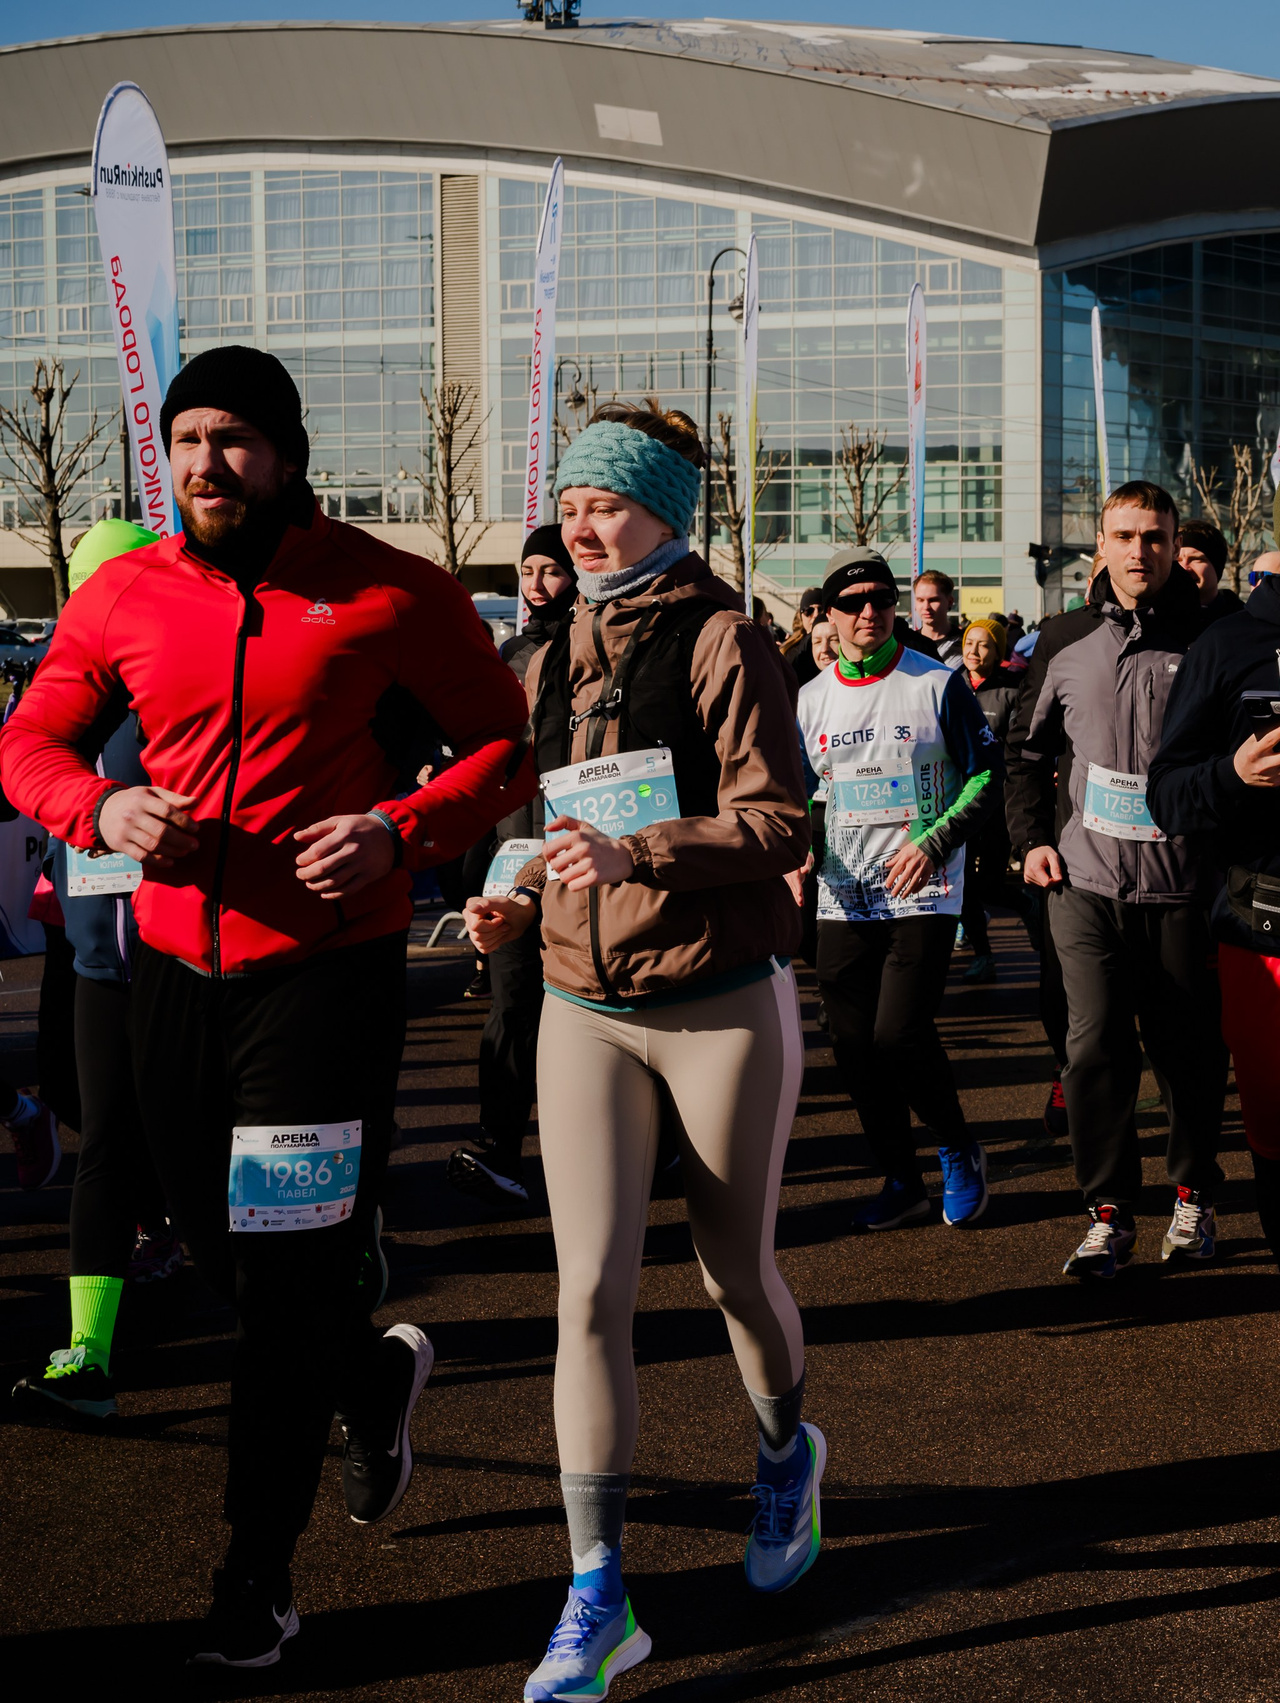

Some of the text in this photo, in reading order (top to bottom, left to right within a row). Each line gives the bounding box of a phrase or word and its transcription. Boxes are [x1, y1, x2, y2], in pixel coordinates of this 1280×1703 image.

[301, 616, 336, 625] odlo
[831, 723, 875, 748] БСПБ
[646, 757, 655, 769] 5
[579, 762, 620, 780] АРЕНА
[856, 766, 883, 775] АРЕНА
[921, 763, 931, 800] БСПБ
[1110, 777, 1139, 788] АРЕНА
[853, 781, 909, 801] 1734 D
[572, 790, 668, 825] 1323 D
[861, 798, 887, 807] СЕРГЕЙ
[1103, 792, 1145, 815] 1755
[1110, 811, 1135, 820] ПАВЕЛ
[100, 860, 125, 869] ЮЛИЯ
[272, 1129, 350, 1143] АРЕНА 5
[261, 1159, 353, 1188] 1986 D
[278, 1184, 356, 1199] ПАВЕЛ 2025
